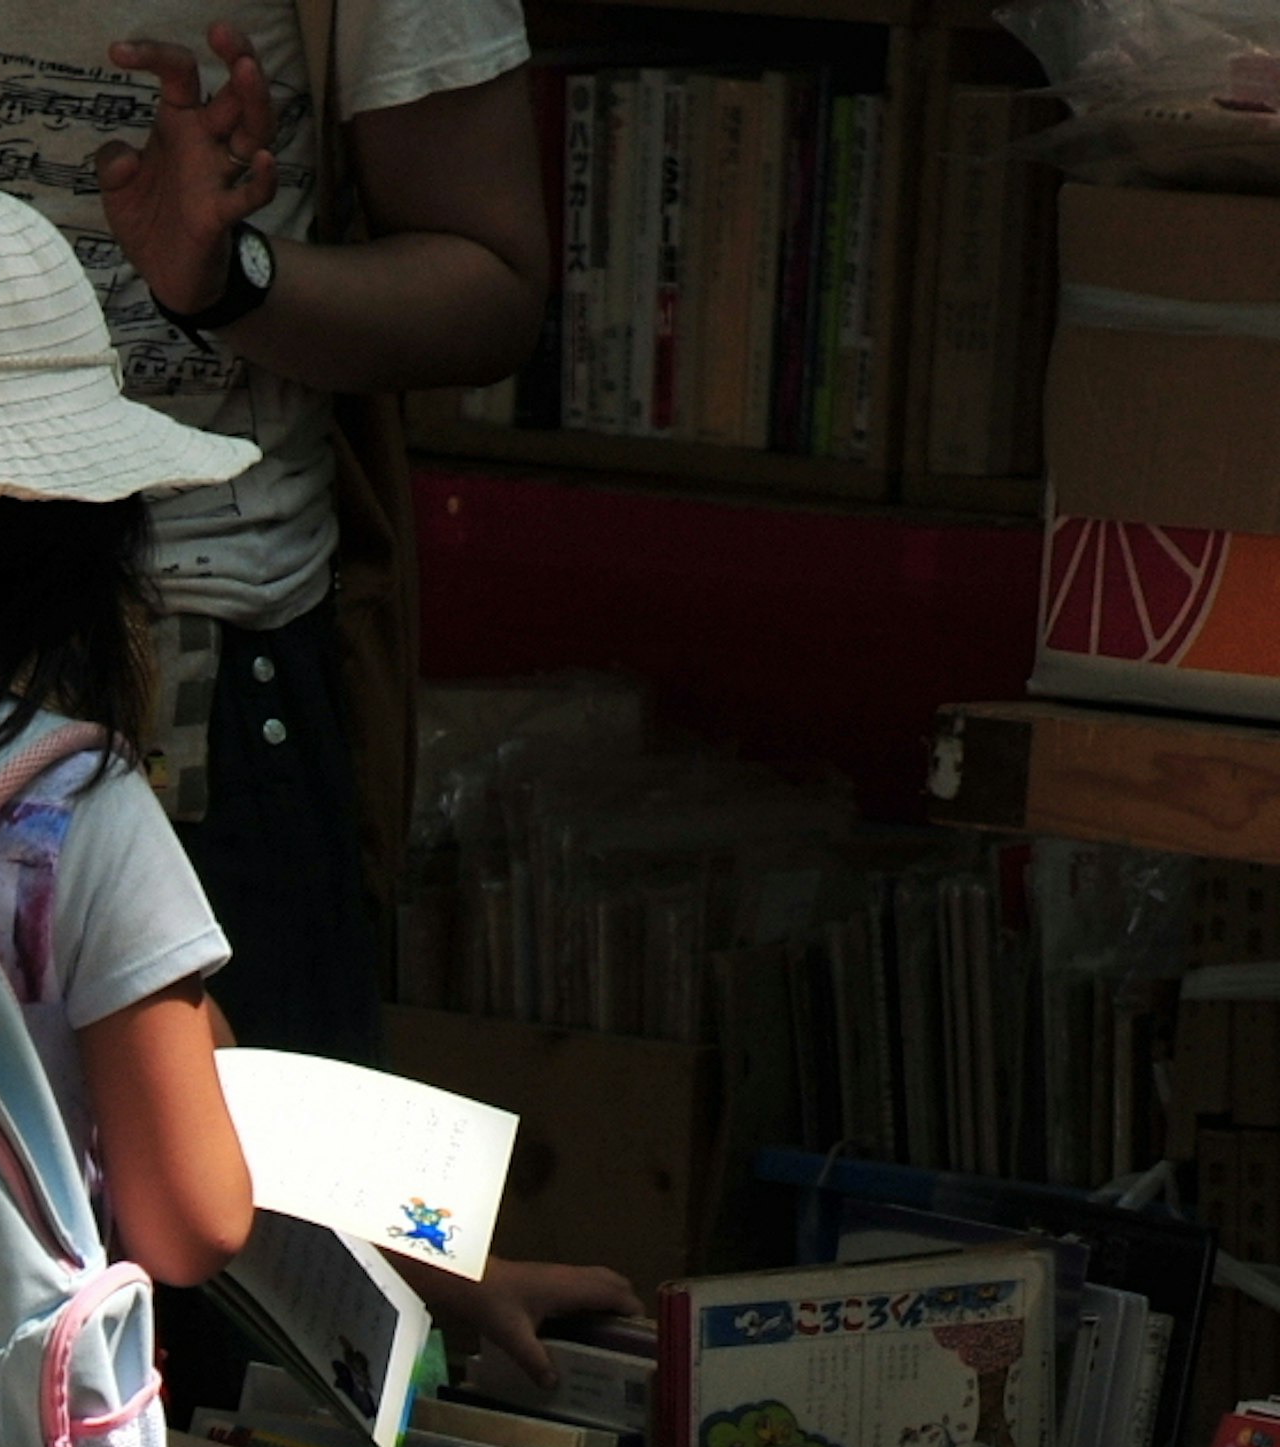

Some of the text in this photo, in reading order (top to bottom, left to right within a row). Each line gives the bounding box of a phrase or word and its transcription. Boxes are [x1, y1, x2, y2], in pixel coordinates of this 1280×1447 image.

[796, 1293, 926, 1336] ころころくん
